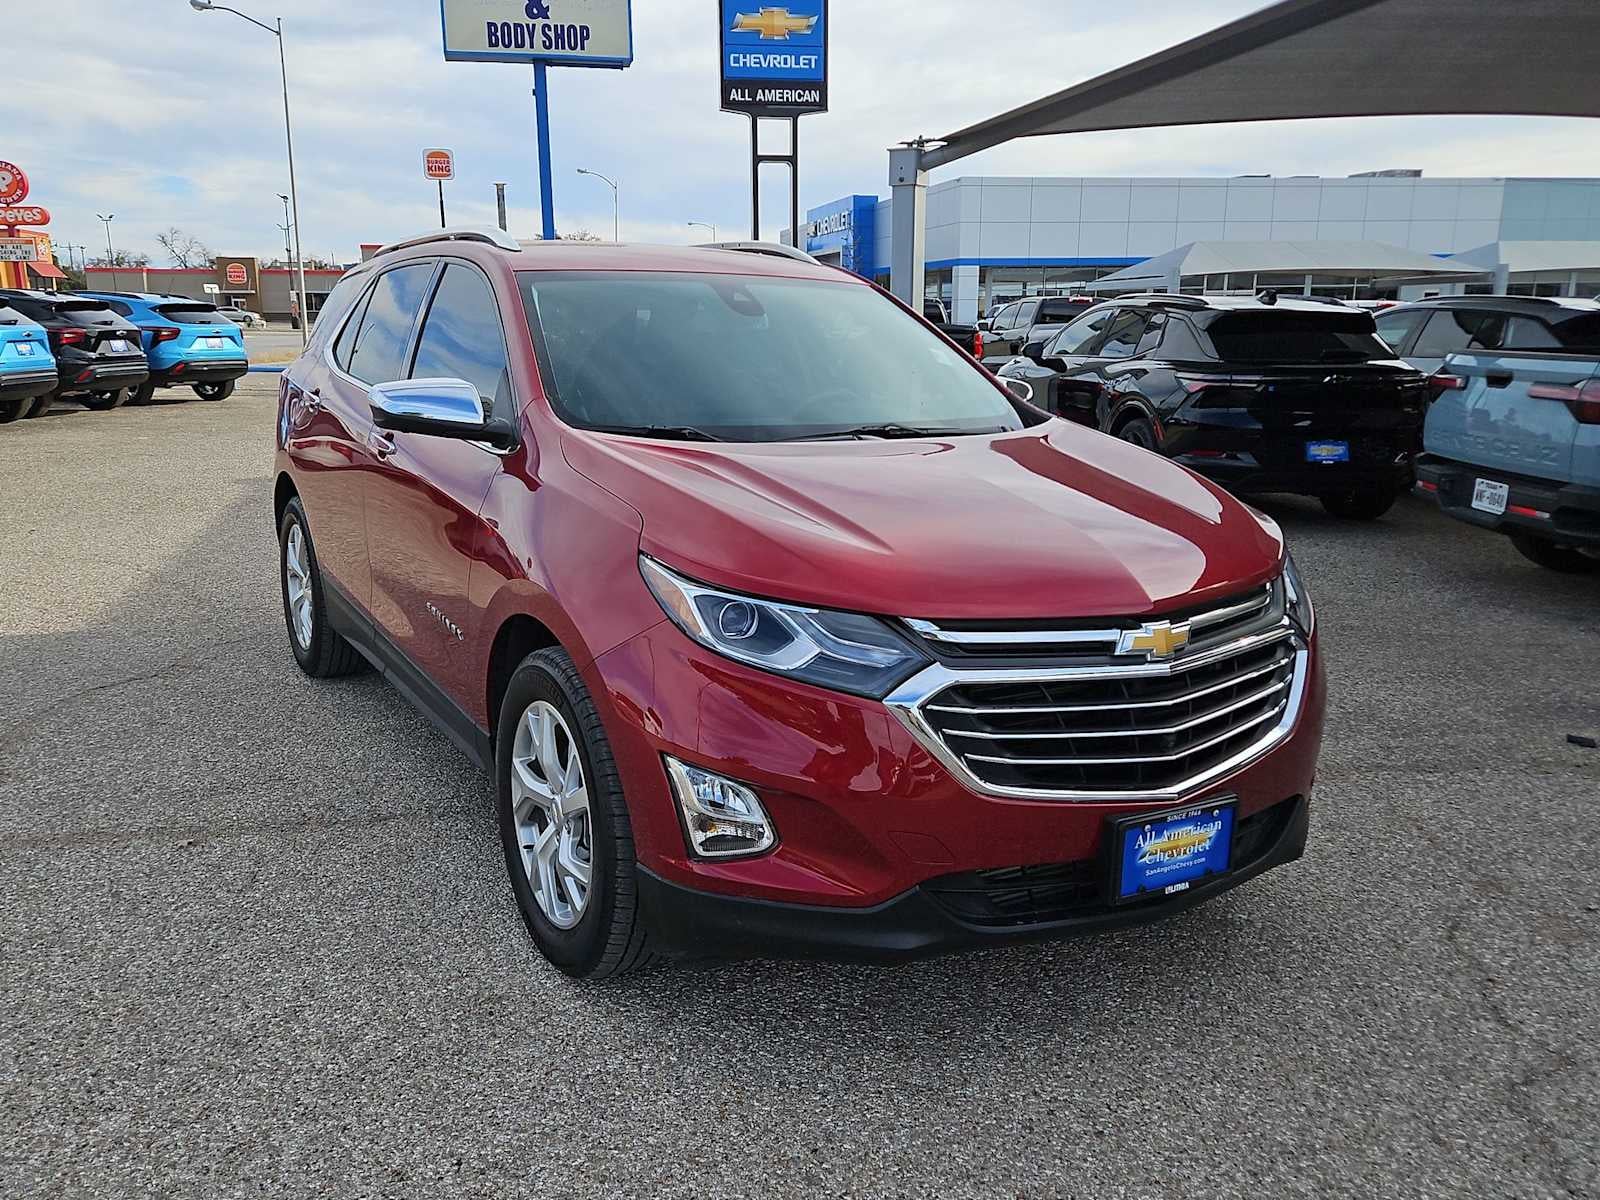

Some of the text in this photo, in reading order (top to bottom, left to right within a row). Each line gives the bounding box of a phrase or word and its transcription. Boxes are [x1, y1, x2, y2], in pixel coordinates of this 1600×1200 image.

[525, 0, 550, 20] &
[487, 22, 590, 51] BODY SHOP
[729, 53, 818, 69] CHEVROLET
[729, 88, 820, 103] ALL AMERICAN
[427, 165, 451, 173] KING
[1167, 812, 1187, 823] SINCE
[1135, 820, 1222, 849] All American
[1144, 838, 1211, 865] Chevrolet
[1144, 857, 1206, 877] SanAngeloChevy.com
